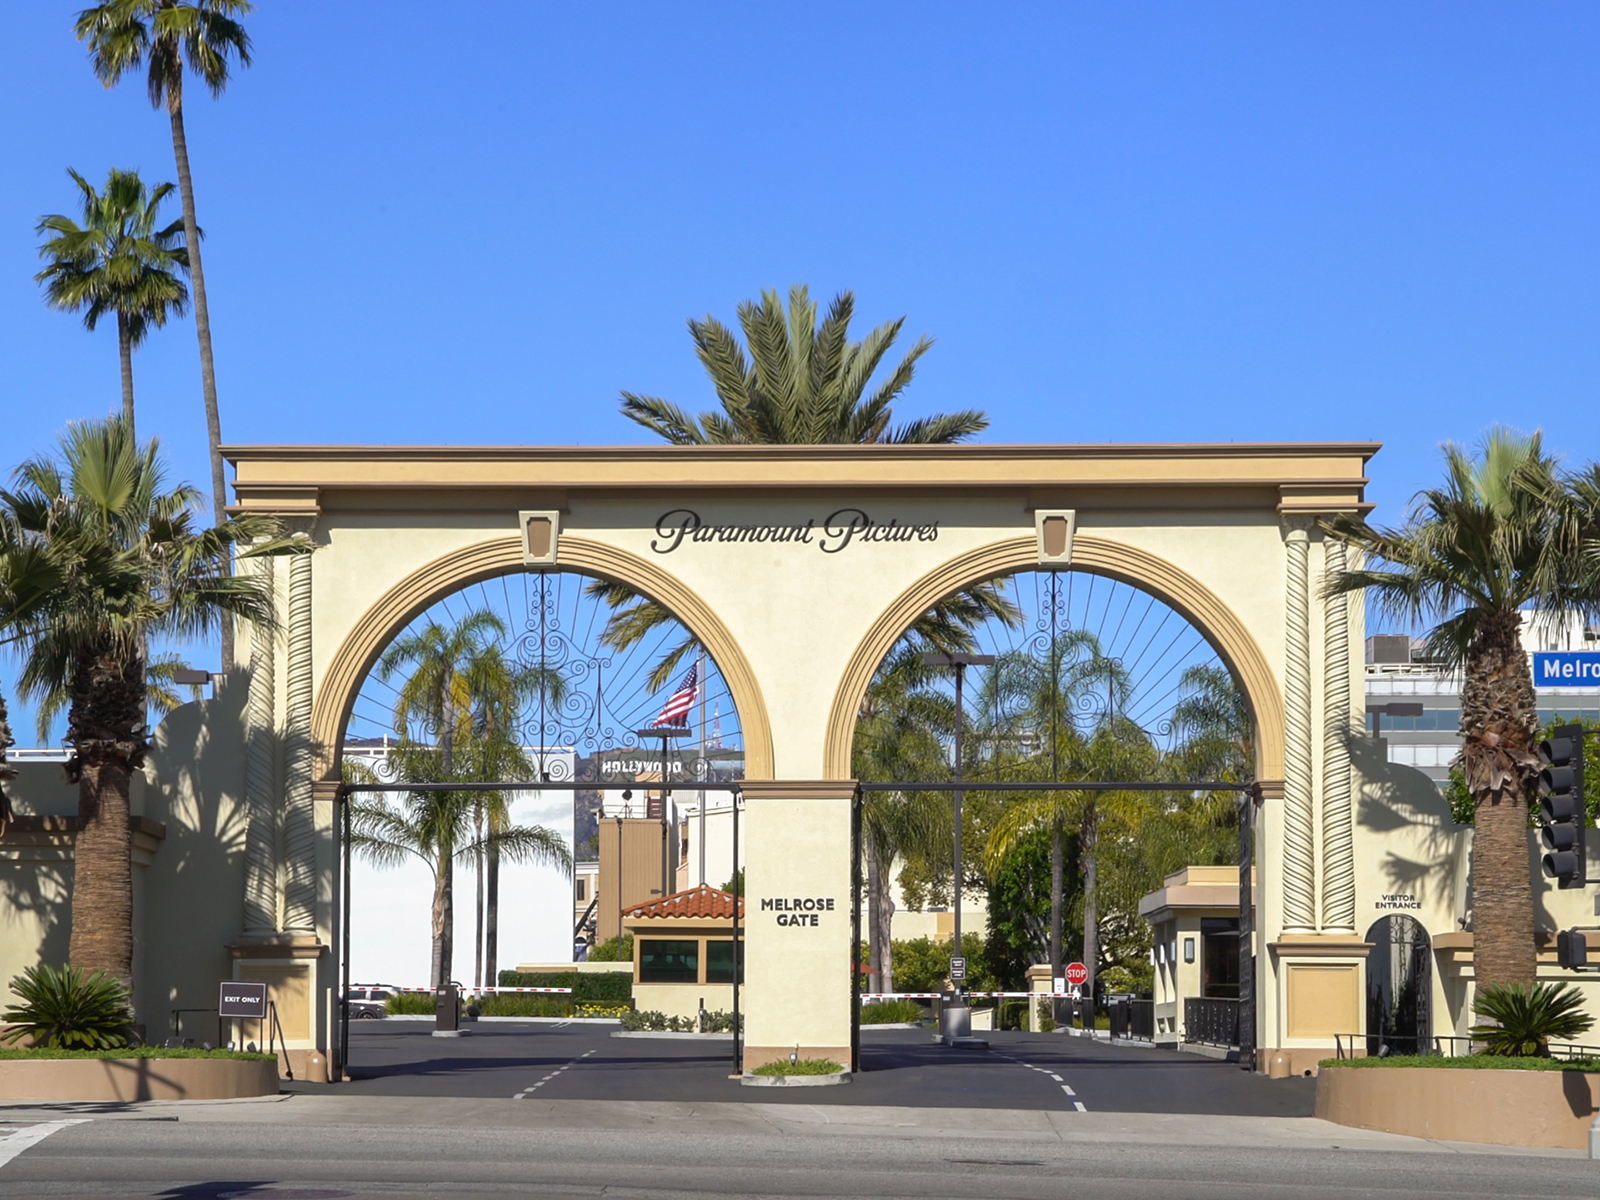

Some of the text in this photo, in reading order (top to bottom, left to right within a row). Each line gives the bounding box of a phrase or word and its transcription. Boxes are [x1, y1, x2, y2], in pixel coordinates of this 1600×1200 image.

[650, 508, 939, 554] Paramount Pictures
[1544, 659, 1600, 678] Melro
[761, 898, 834, 911] MELROSE
[776, 914, 819, 926] GATE
[1067, 969, 1086, 978] STOP
